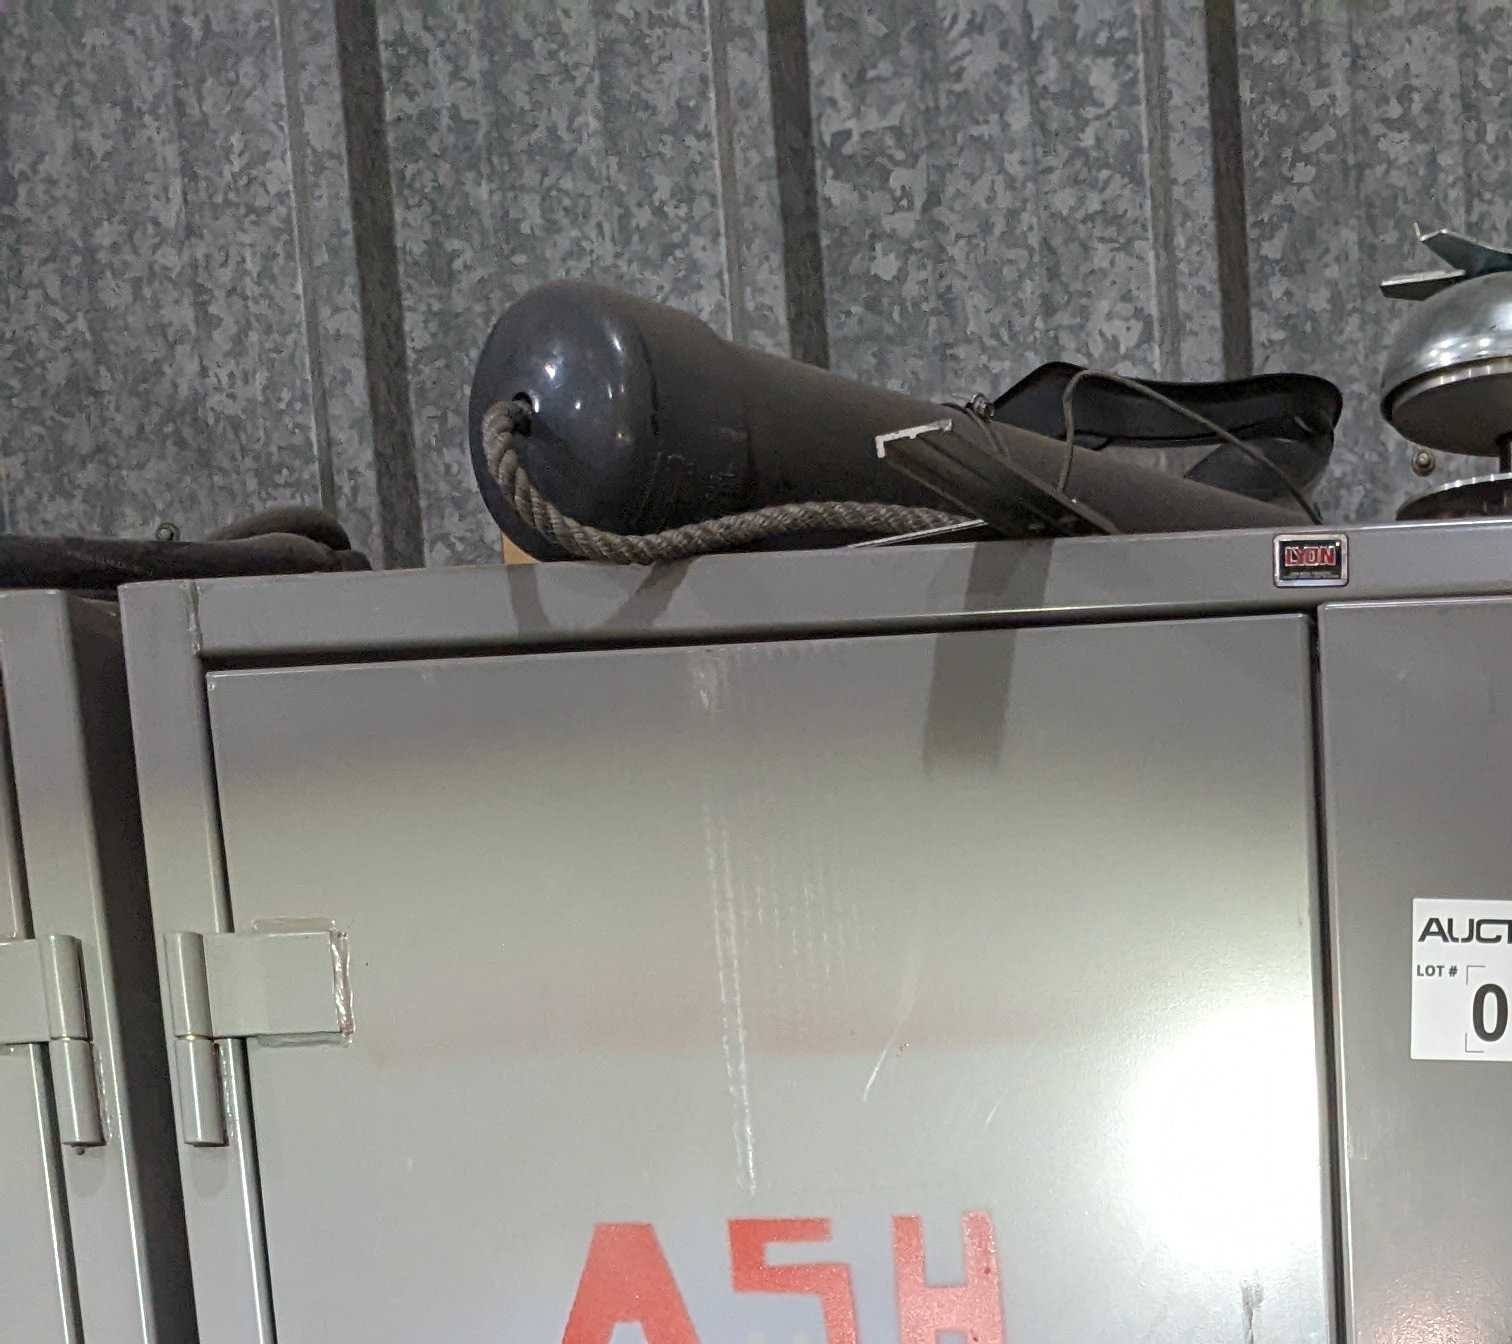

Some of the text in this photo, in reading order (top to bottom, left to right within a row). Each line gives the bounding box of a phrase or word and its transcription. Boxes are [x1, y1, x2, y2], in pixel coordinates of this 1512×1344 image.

[1285, 546, 1336, 567] LYON
[1417, 965, 1458, 977] LOT #
